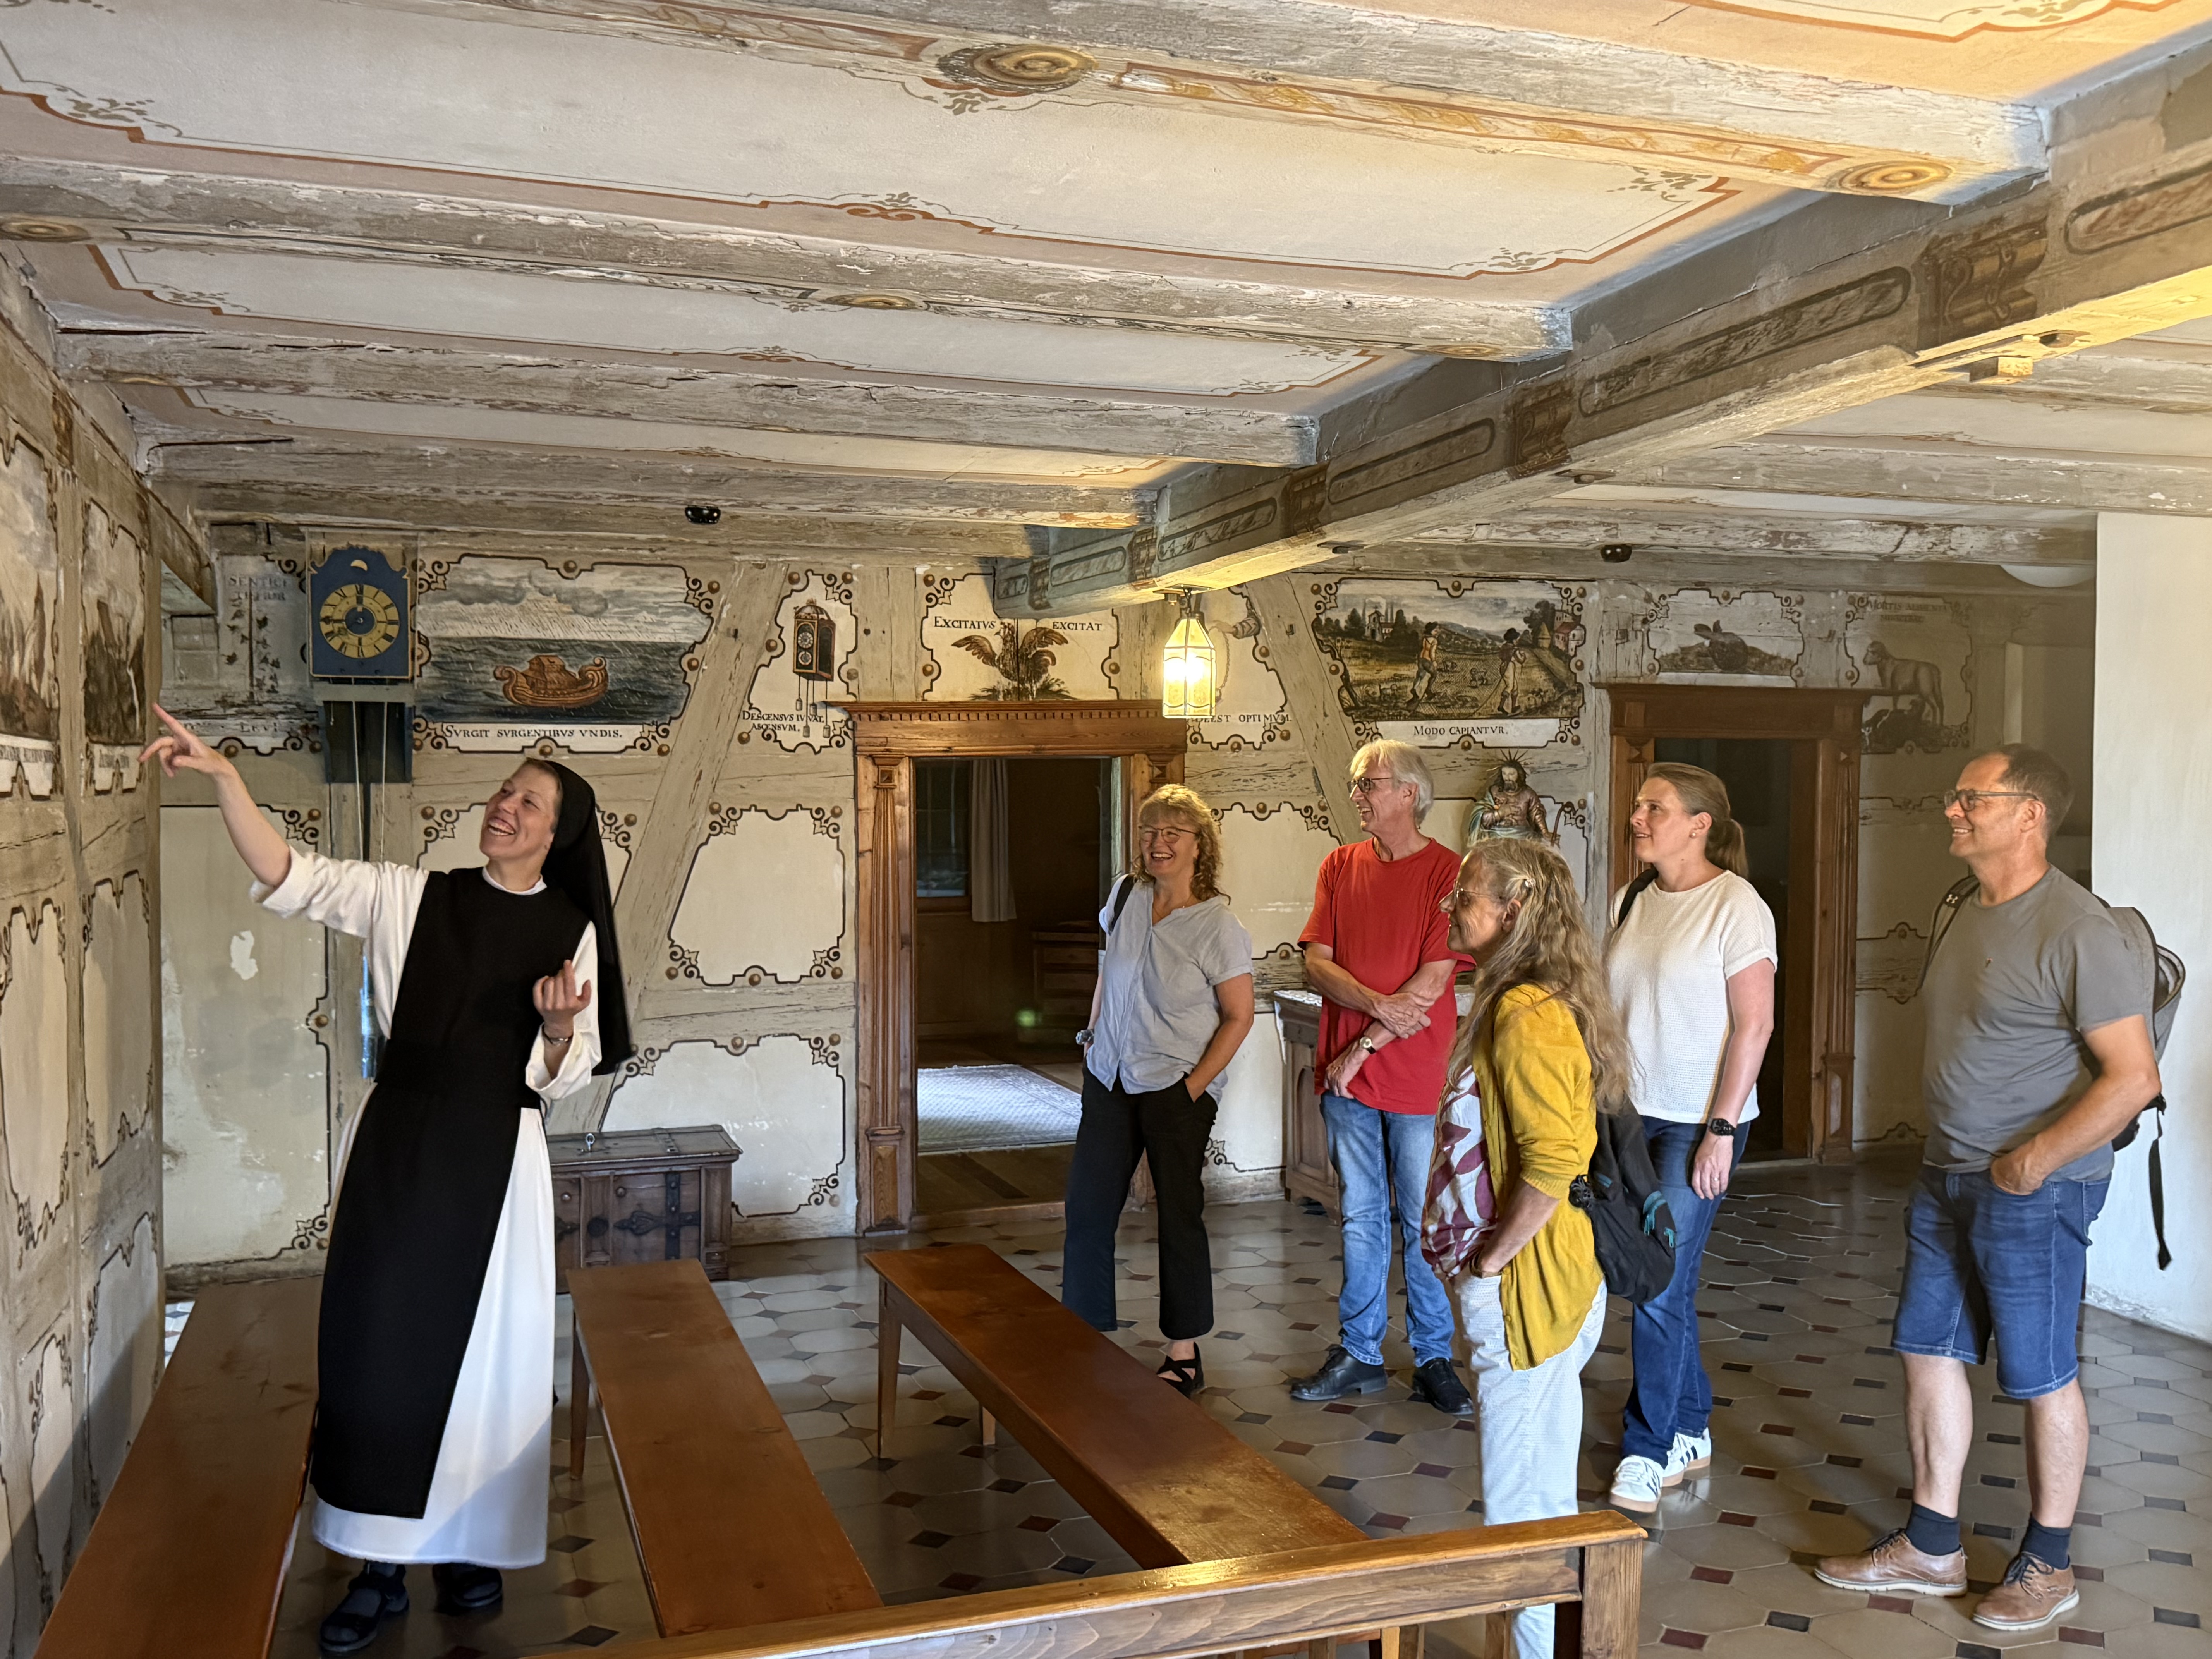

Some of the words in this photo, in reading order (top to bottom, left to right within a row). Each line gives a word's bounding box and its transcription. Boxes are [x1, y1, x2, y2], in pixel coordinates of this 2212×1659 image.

[934, 616, 996, 629] EXCITATVS
[1053, 622, 1102, 631] EXCITAT
[742, 710, 794, 721] DESCENSVS
[445, 725, 490, 737] SVRGIT
[497, 729, 574, 737] SVRGENTIBVS
[579, 730, 622, 738] VNDIS.
[1414, 725, 1445, 735] MODO
